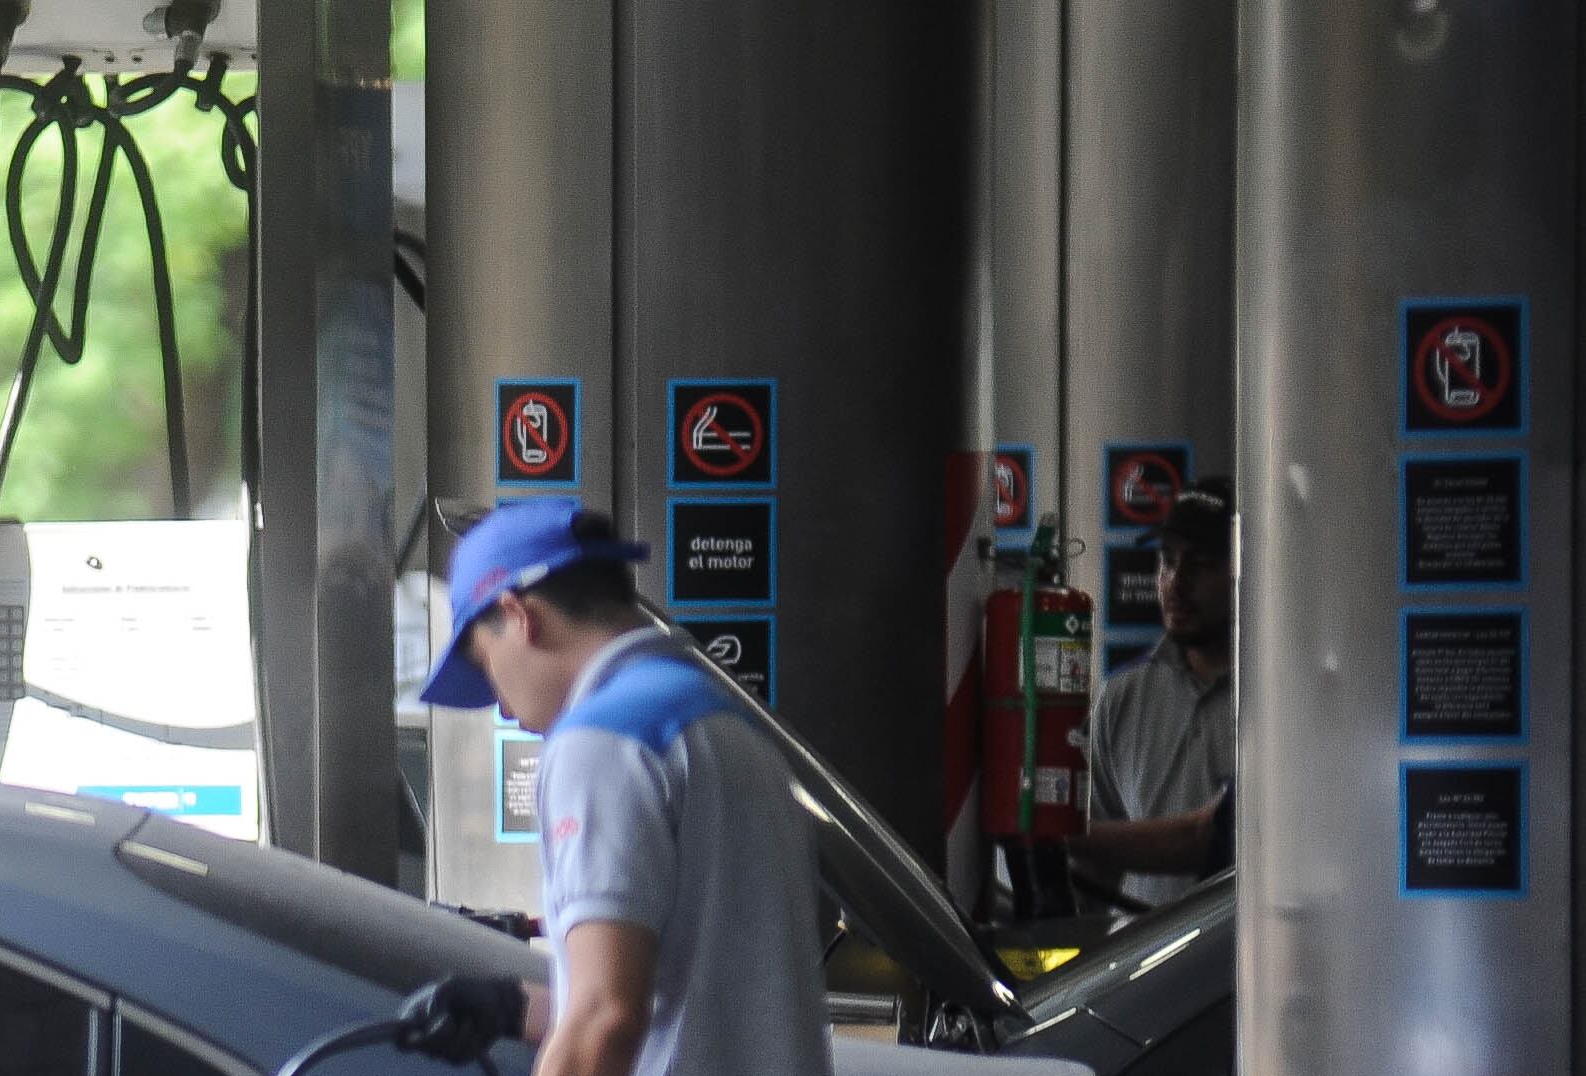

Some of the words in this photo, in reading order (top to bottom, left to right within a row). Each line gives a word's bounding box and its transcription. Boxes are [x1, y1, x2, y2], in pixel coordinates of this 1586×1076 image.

[691, 537, 753, 554] detenga
[688, 554, 704, 570] el
[708, 555, 755, 570] motor
